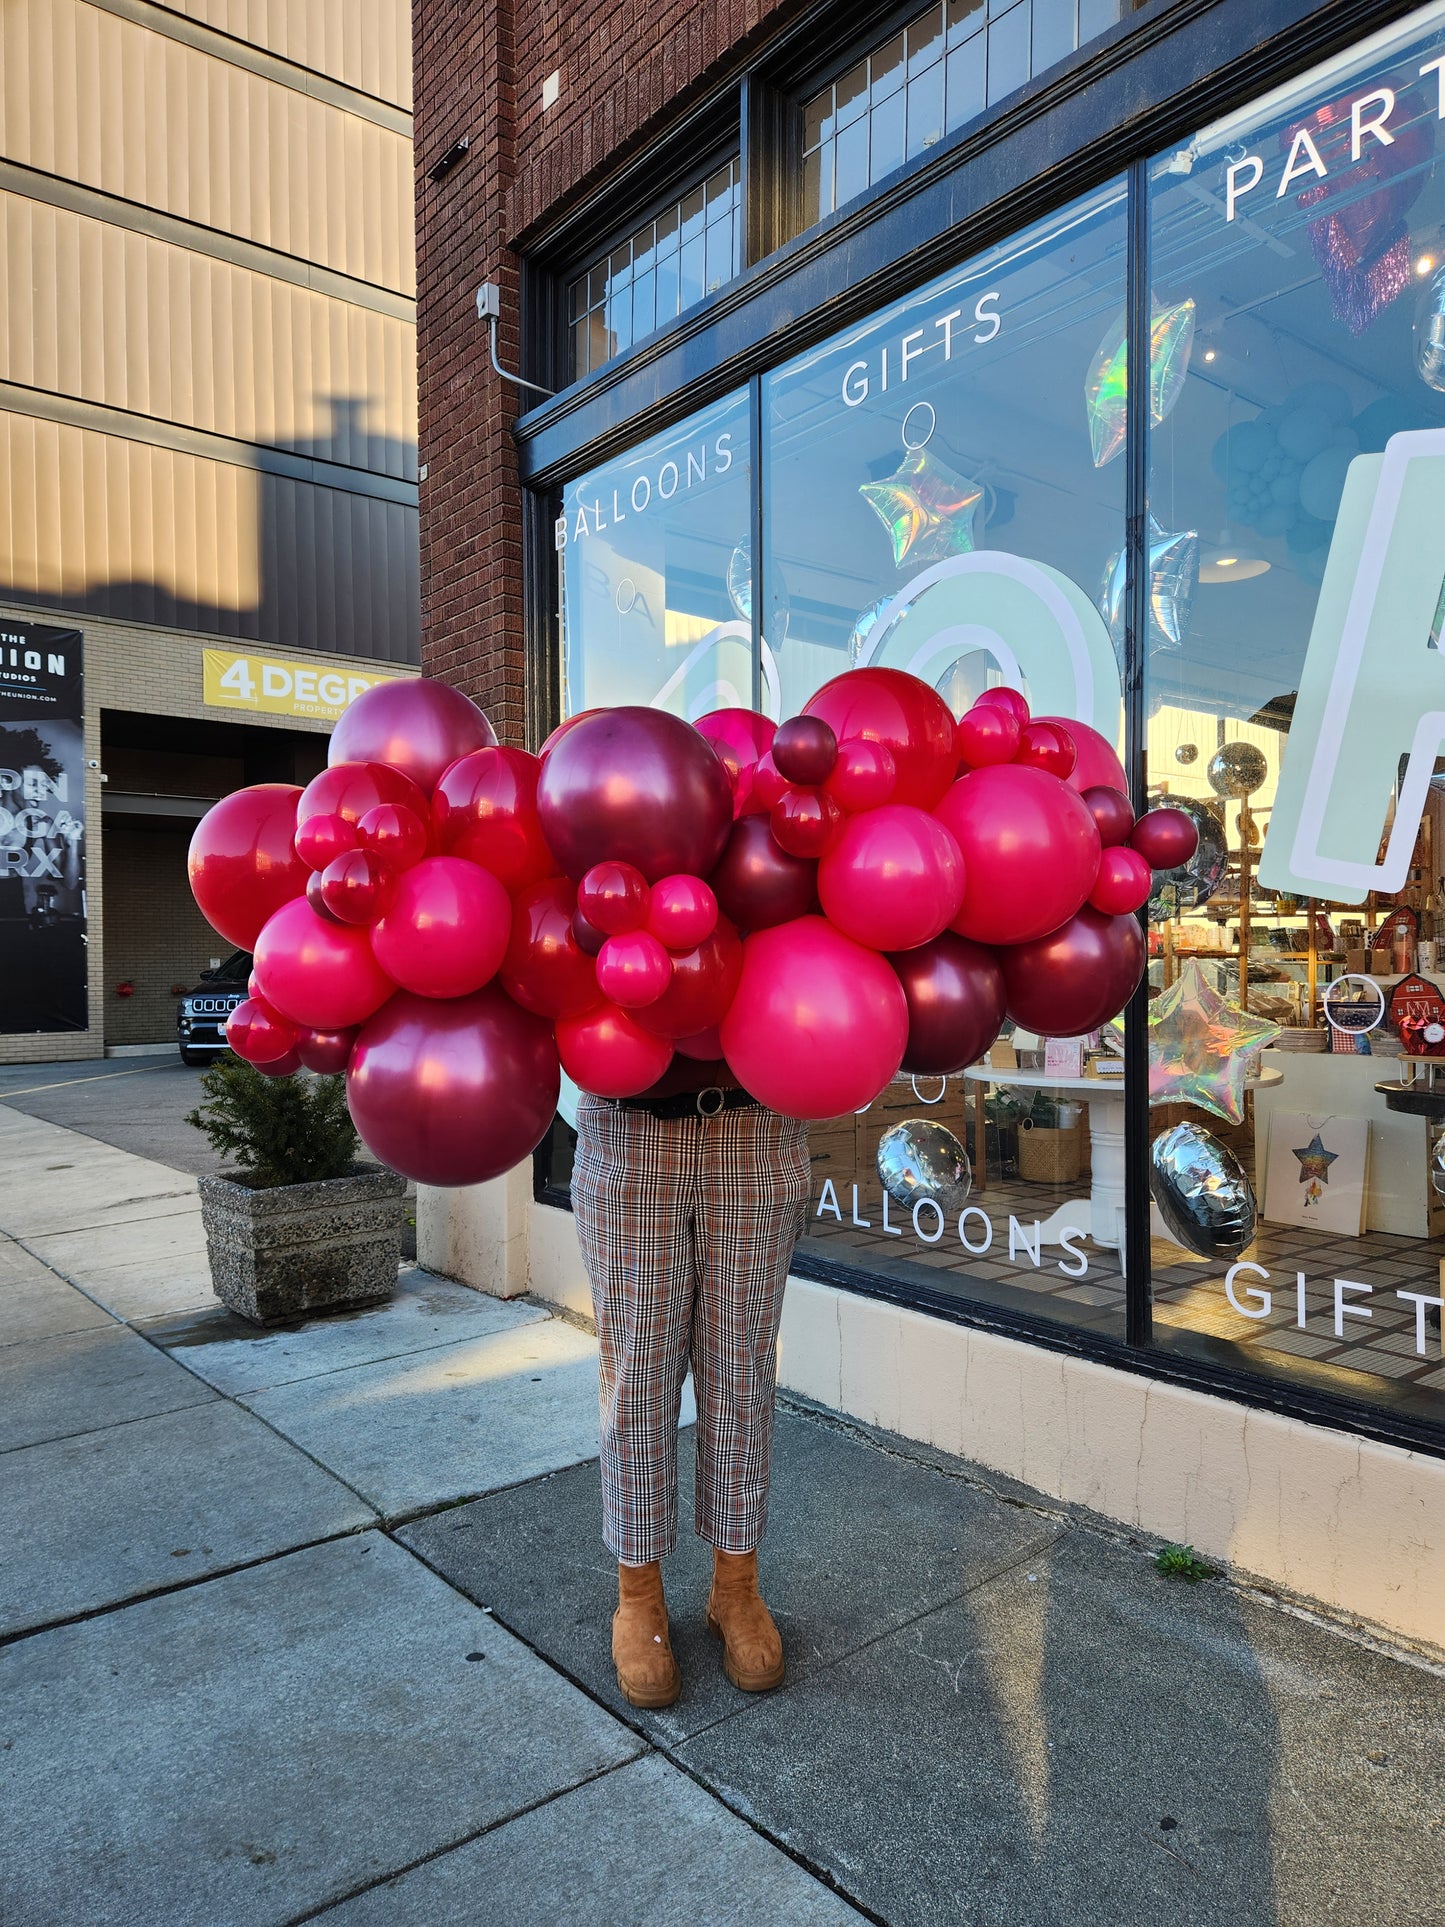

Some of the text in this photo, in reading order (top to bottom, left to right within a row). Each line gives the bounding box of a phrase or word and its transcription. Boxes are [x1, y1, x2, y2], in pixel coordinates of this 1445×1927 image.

[841, 292, 1001, 407] GIFTS
[554, 433, 733, 551] BALLOONS
[0, 633, 26, 645] THE
[0, 646, 65, 677] ION
[219, 658, 256, 699] 4
[815, 1178, 1090, 1277] ALLOONS
